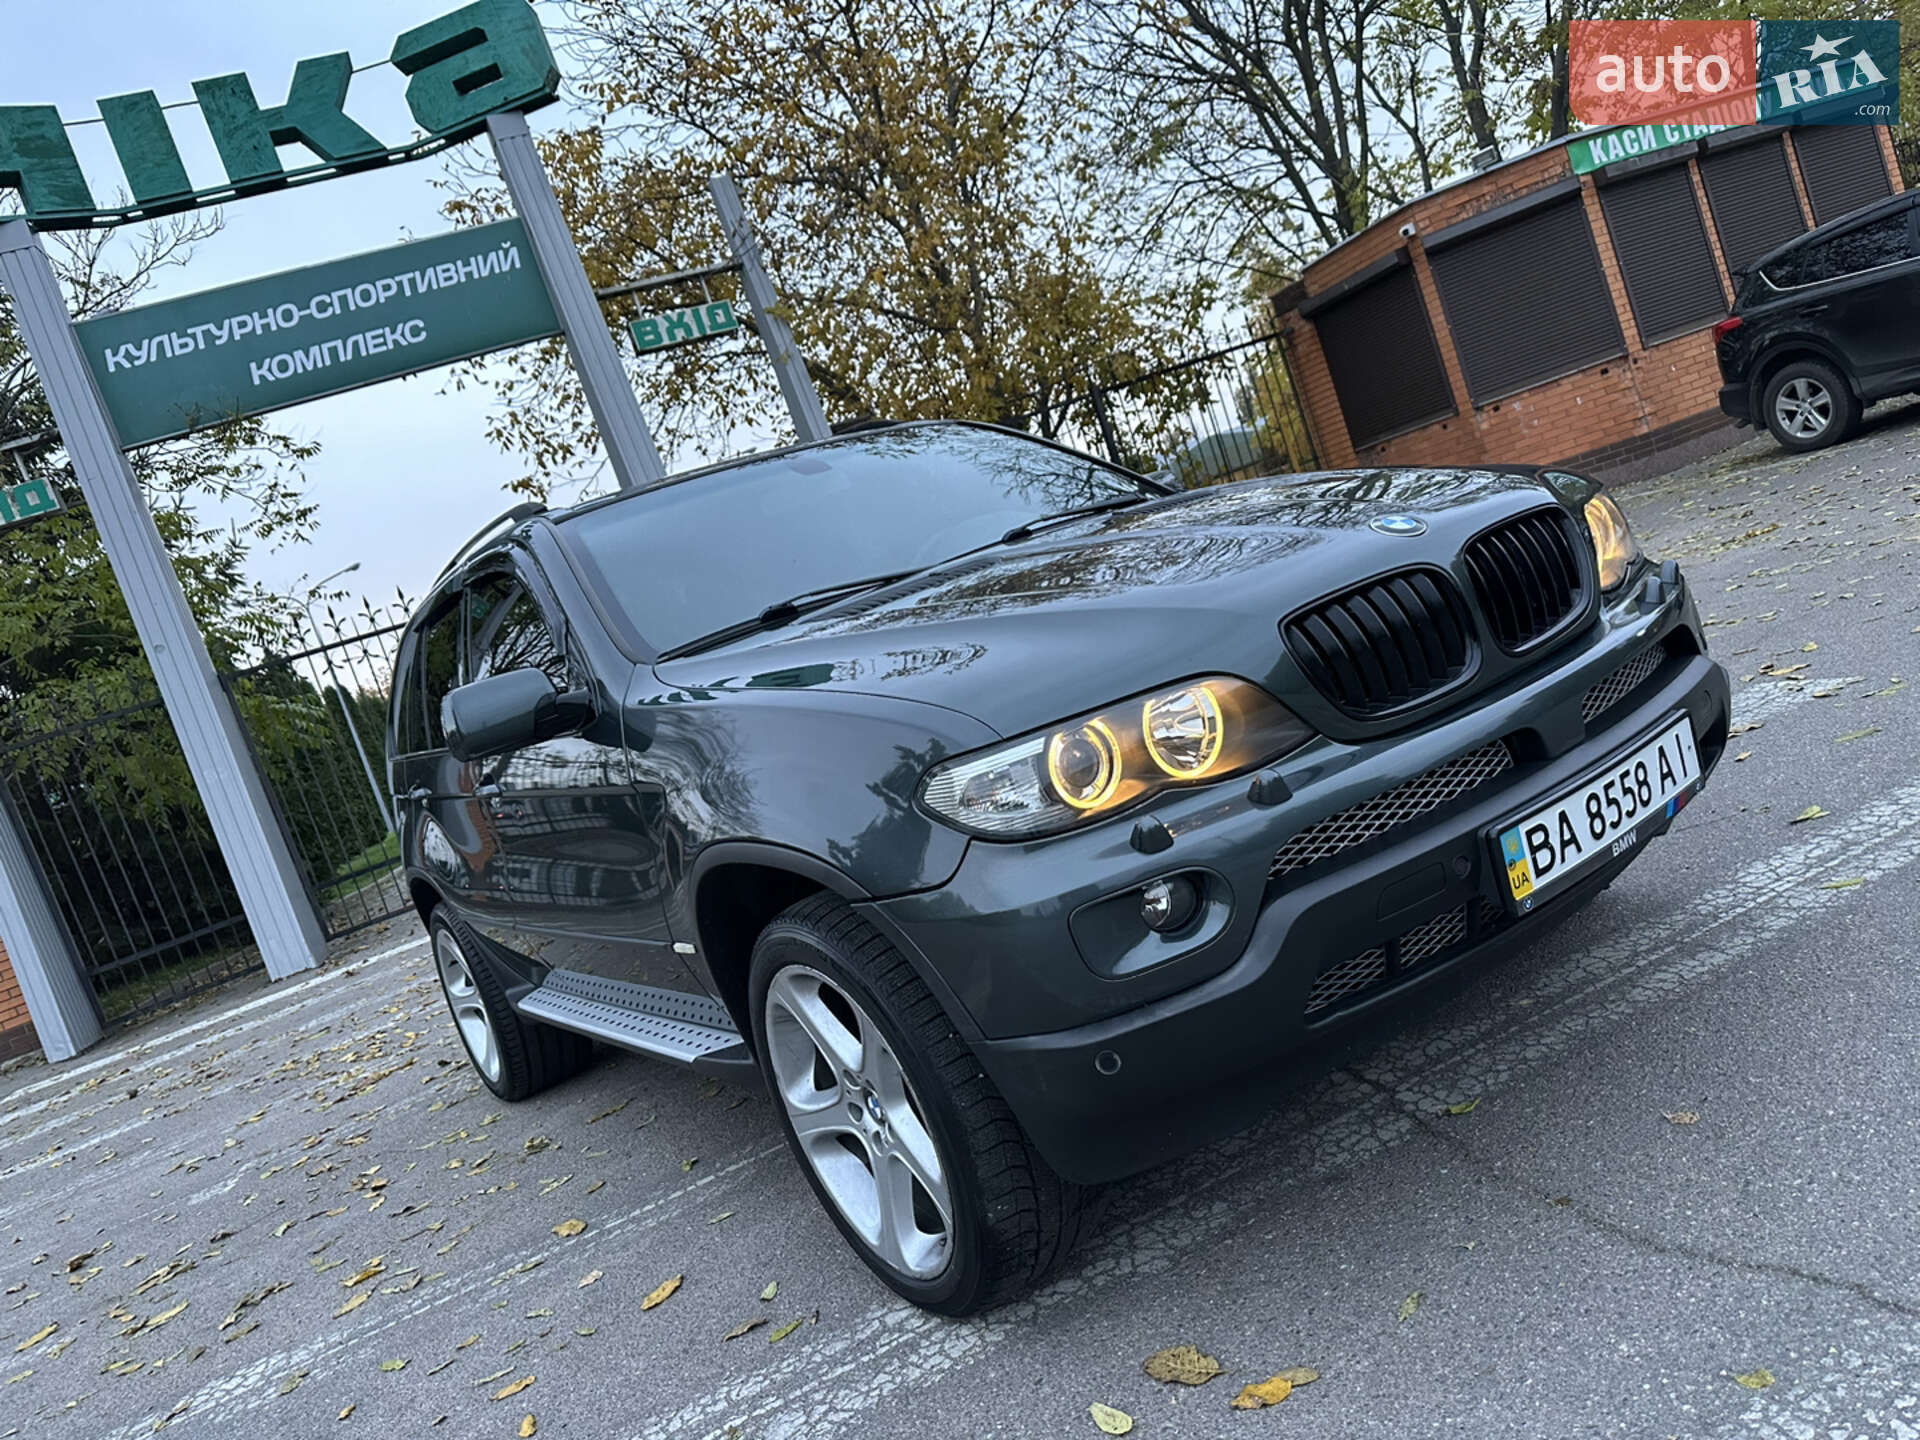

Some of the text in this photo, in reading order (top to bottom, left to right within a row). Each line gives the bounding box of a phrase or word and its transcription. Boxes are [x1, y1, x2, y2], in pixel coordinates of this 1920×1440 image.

[1588, 126, 1657, 165] КАСИ
[104, 240, 521, 373] КУЛЬТУРНО-СПОРТИВНИЙ
[249, 318, 427, 385] КОМПЛЕКС
[1525, 733, 1688, 880] BA 8558 AI
[1612, 828, 1637, 857] BMW
[1512, 872, 1530, 889] UA
